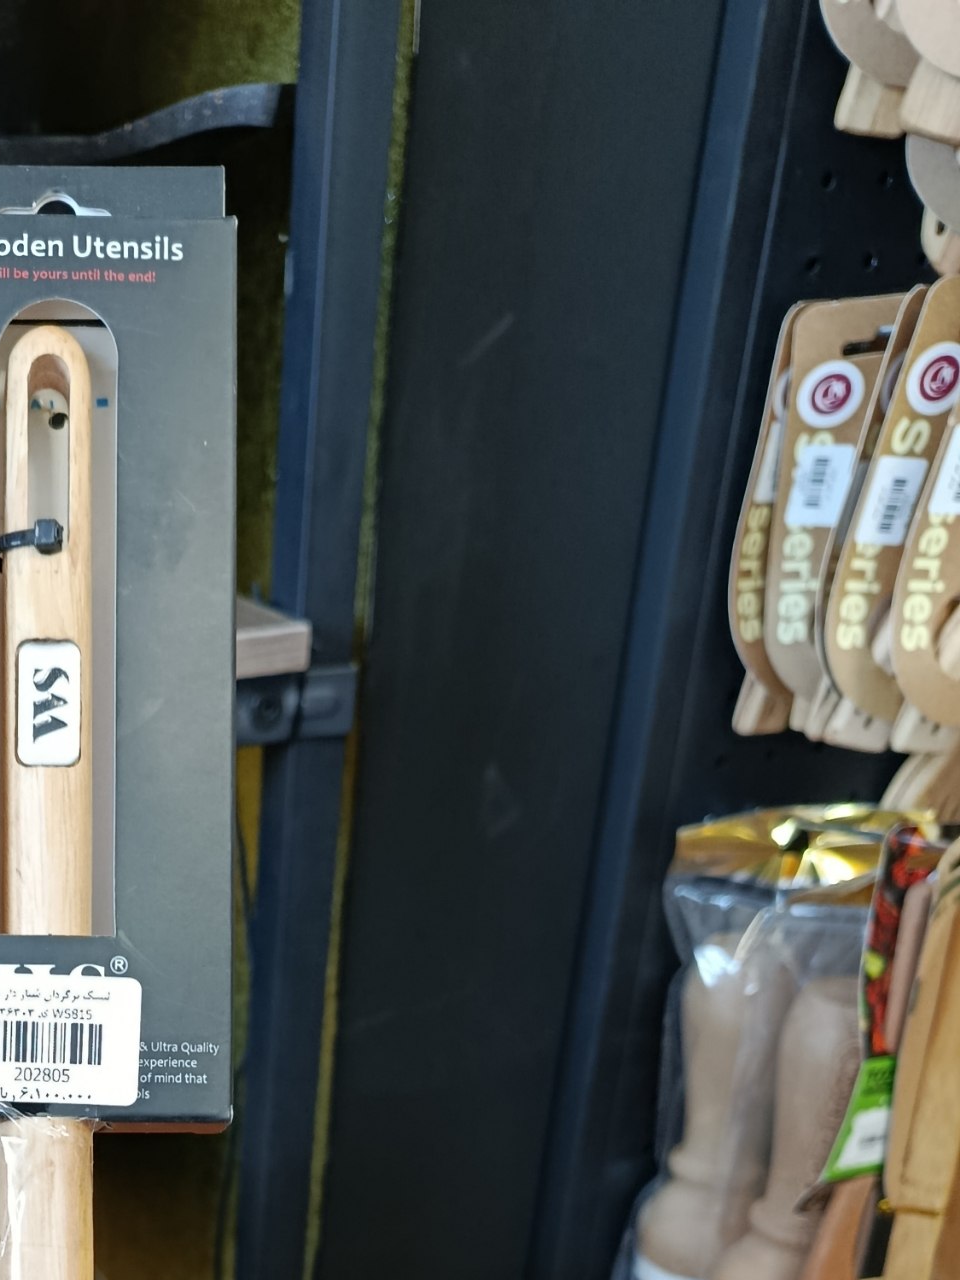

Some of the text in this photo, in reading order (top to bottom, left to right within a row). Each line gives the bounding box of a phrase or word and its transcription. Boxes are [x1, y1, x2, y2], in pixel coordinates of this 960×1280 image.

[73, 235, 184, 261] Utensils
[13, 268, 29, 279] be
[32, 269, 68, 282] yours
[71, 269, 100, 281] until
[103, 269, 125, 282] the
[128, 270, 156, 283] end!
[776, 528, 819, 645] eries
[33, 667, 69, 744] WS
[52, 1008, 92, 1020] WS815
[151, 1041, 178, 1052] Ultra
[181, 1042, 220, 1056] Quality
[138, 1057, 198, 1070] experience
[14, 1066, 71, 1083] 202805
[140, 1072, 208, 1084] of mind that
